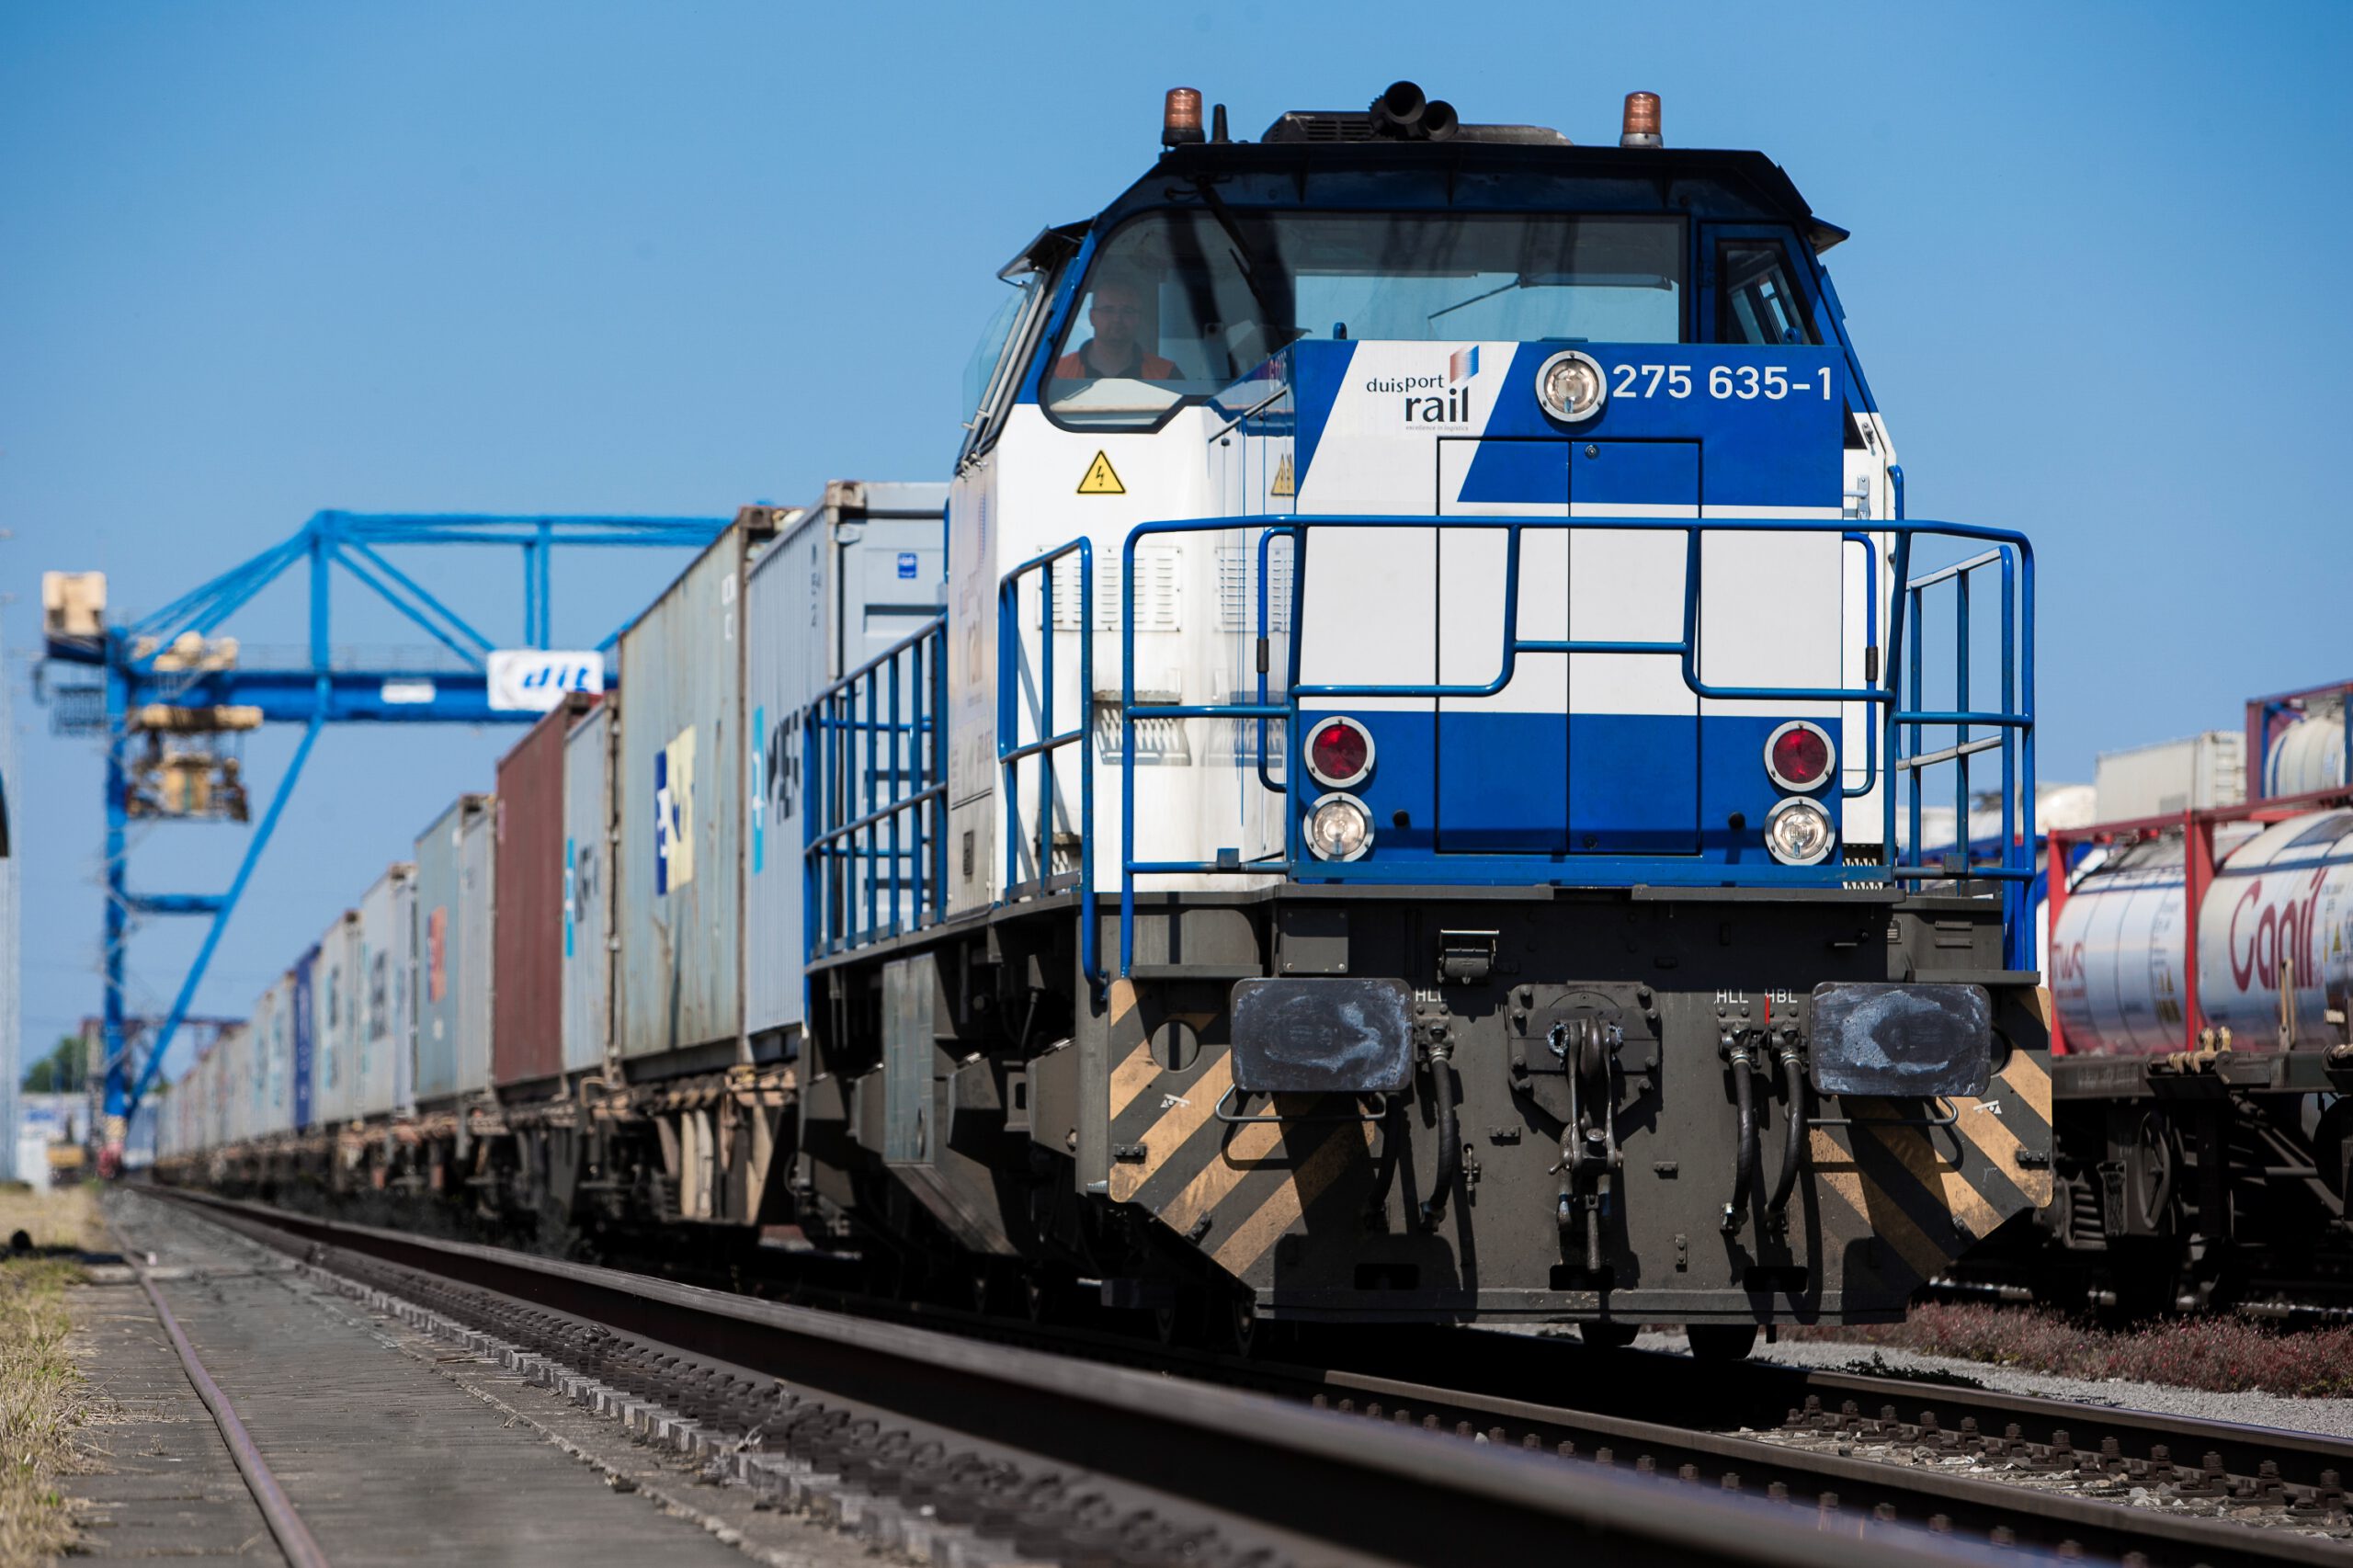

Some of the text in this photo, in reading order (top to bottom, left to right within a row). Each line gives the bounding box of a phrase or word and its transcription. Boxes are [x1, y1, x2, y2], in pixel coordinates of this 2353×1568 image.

[1366, 374, 1445, 392] duisport
[1612, 364, 1831, 401] 275 635-1
[1405, 386, 1469, 423] rail
[1716, 989, 1749, 1004] HLL
[1765, 988, 1798, 1004] HBL
